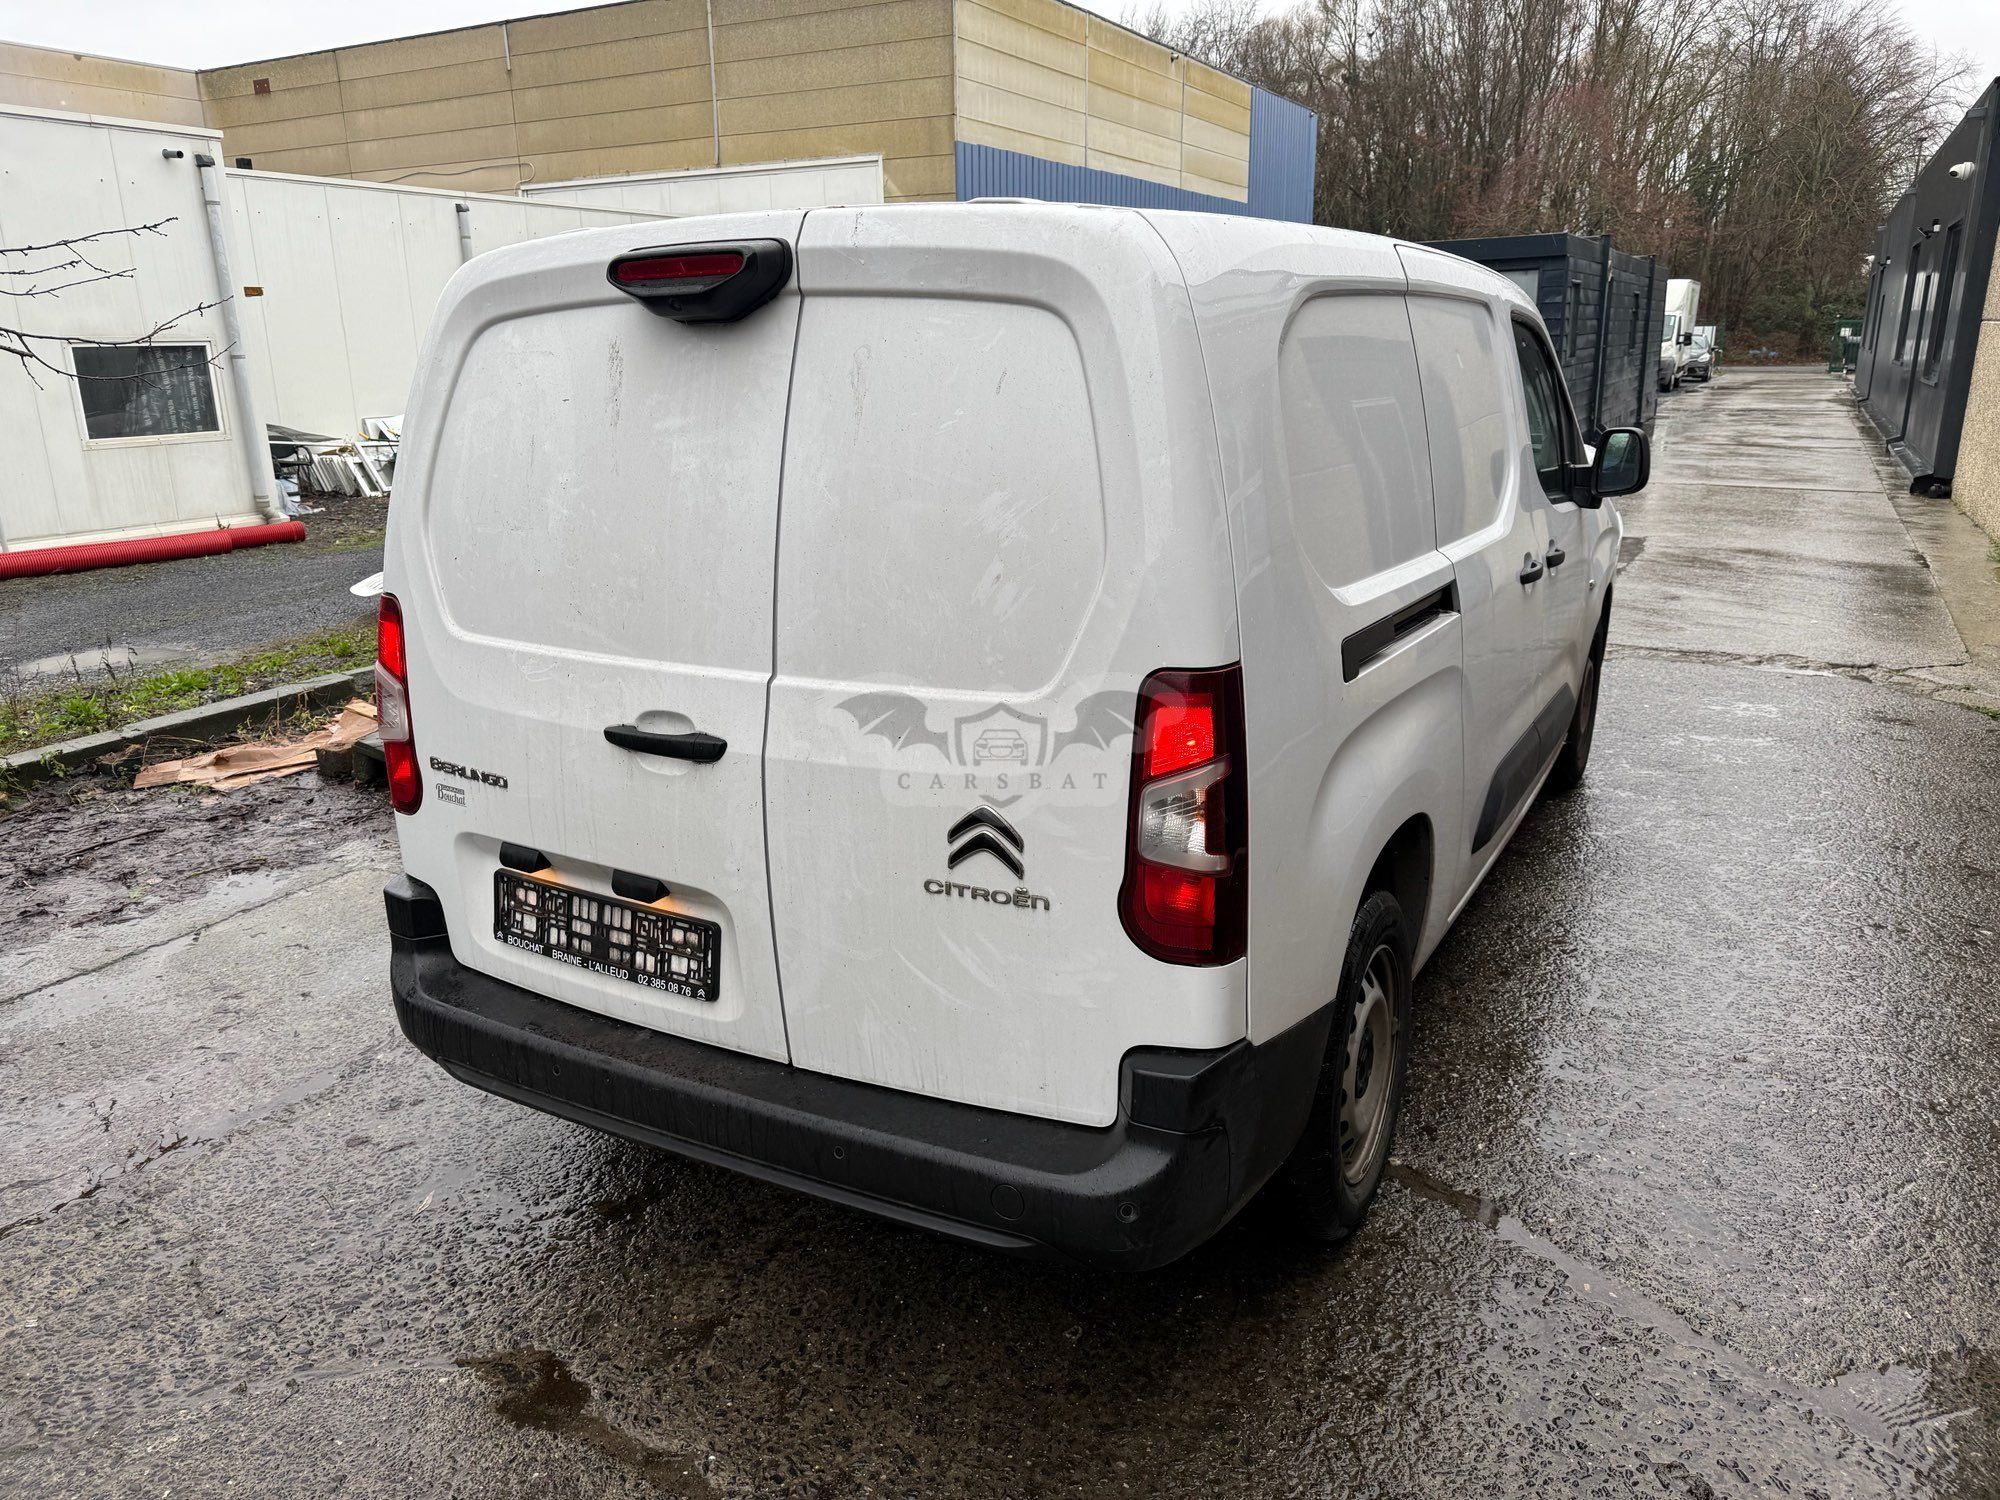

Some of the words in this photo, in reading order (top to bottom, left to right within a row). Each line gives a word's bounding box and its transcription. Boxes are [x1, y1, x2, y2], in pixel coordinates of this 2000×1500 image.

[429, 756, 509, 789] BERLINGO
[507, 935, 545, 955] BOUCHAT
[552, 949, 582, 967] BRAINE
[637, 974, 648, 987] 02
[650, 977, 666, 991] 385
[667, 981, 679, 994] 08
[681, 984, 692, 998] 76
